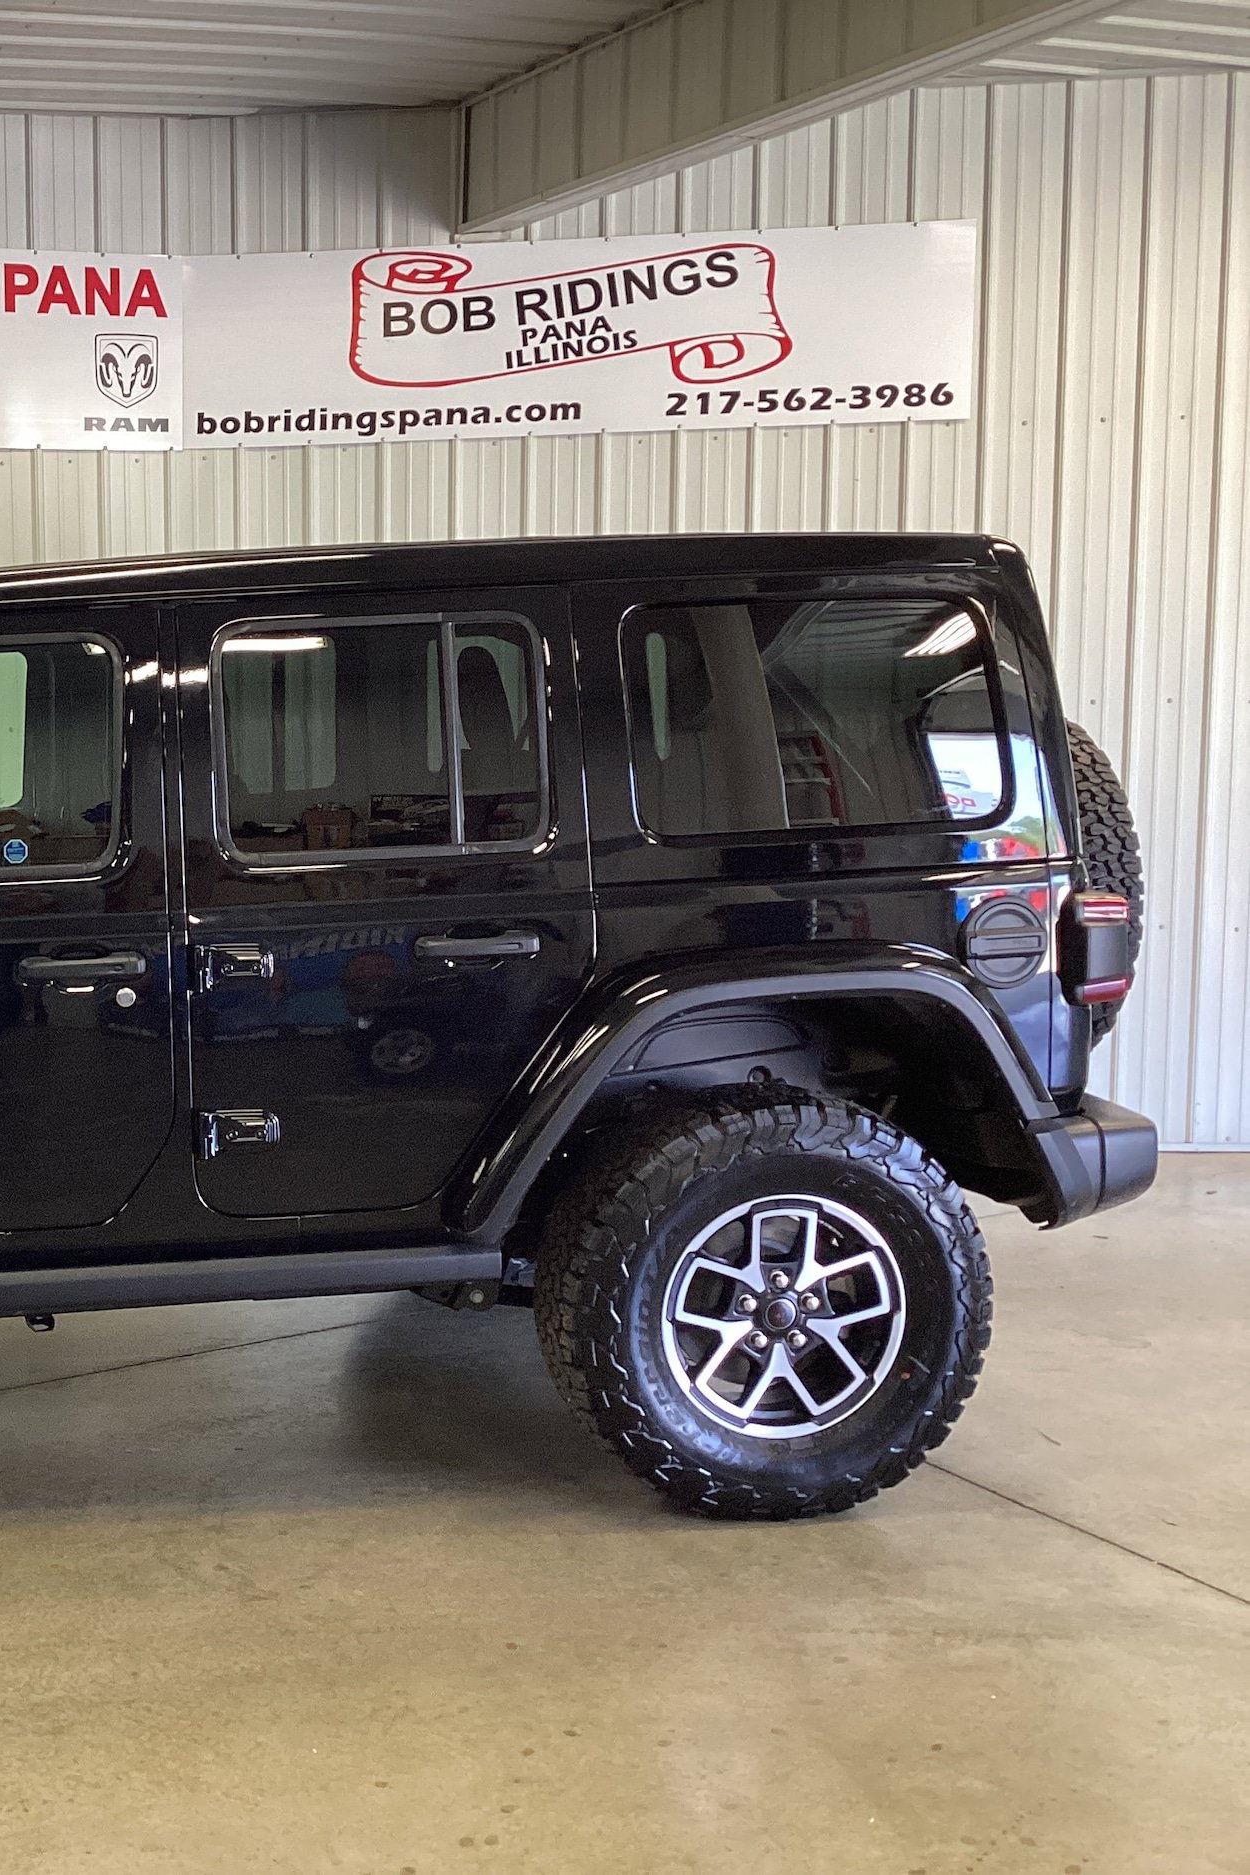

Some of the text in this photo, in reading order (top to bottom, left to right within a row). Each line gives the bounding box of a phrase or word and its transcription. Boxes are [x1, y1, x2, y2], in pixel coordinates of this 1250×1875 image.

[3, 262, 168, 318] PANA
[383, 251, 739, 338] BOB RIDINGS
[521, 315, 613, 347] PANA
[505, 330, 638, 370] ILLINOIS
[666, 382, 955, 416] 217-562-3986
[84, 417, 169, 432] RAM
[196, 401, 582, 436] bobridingspana.com
